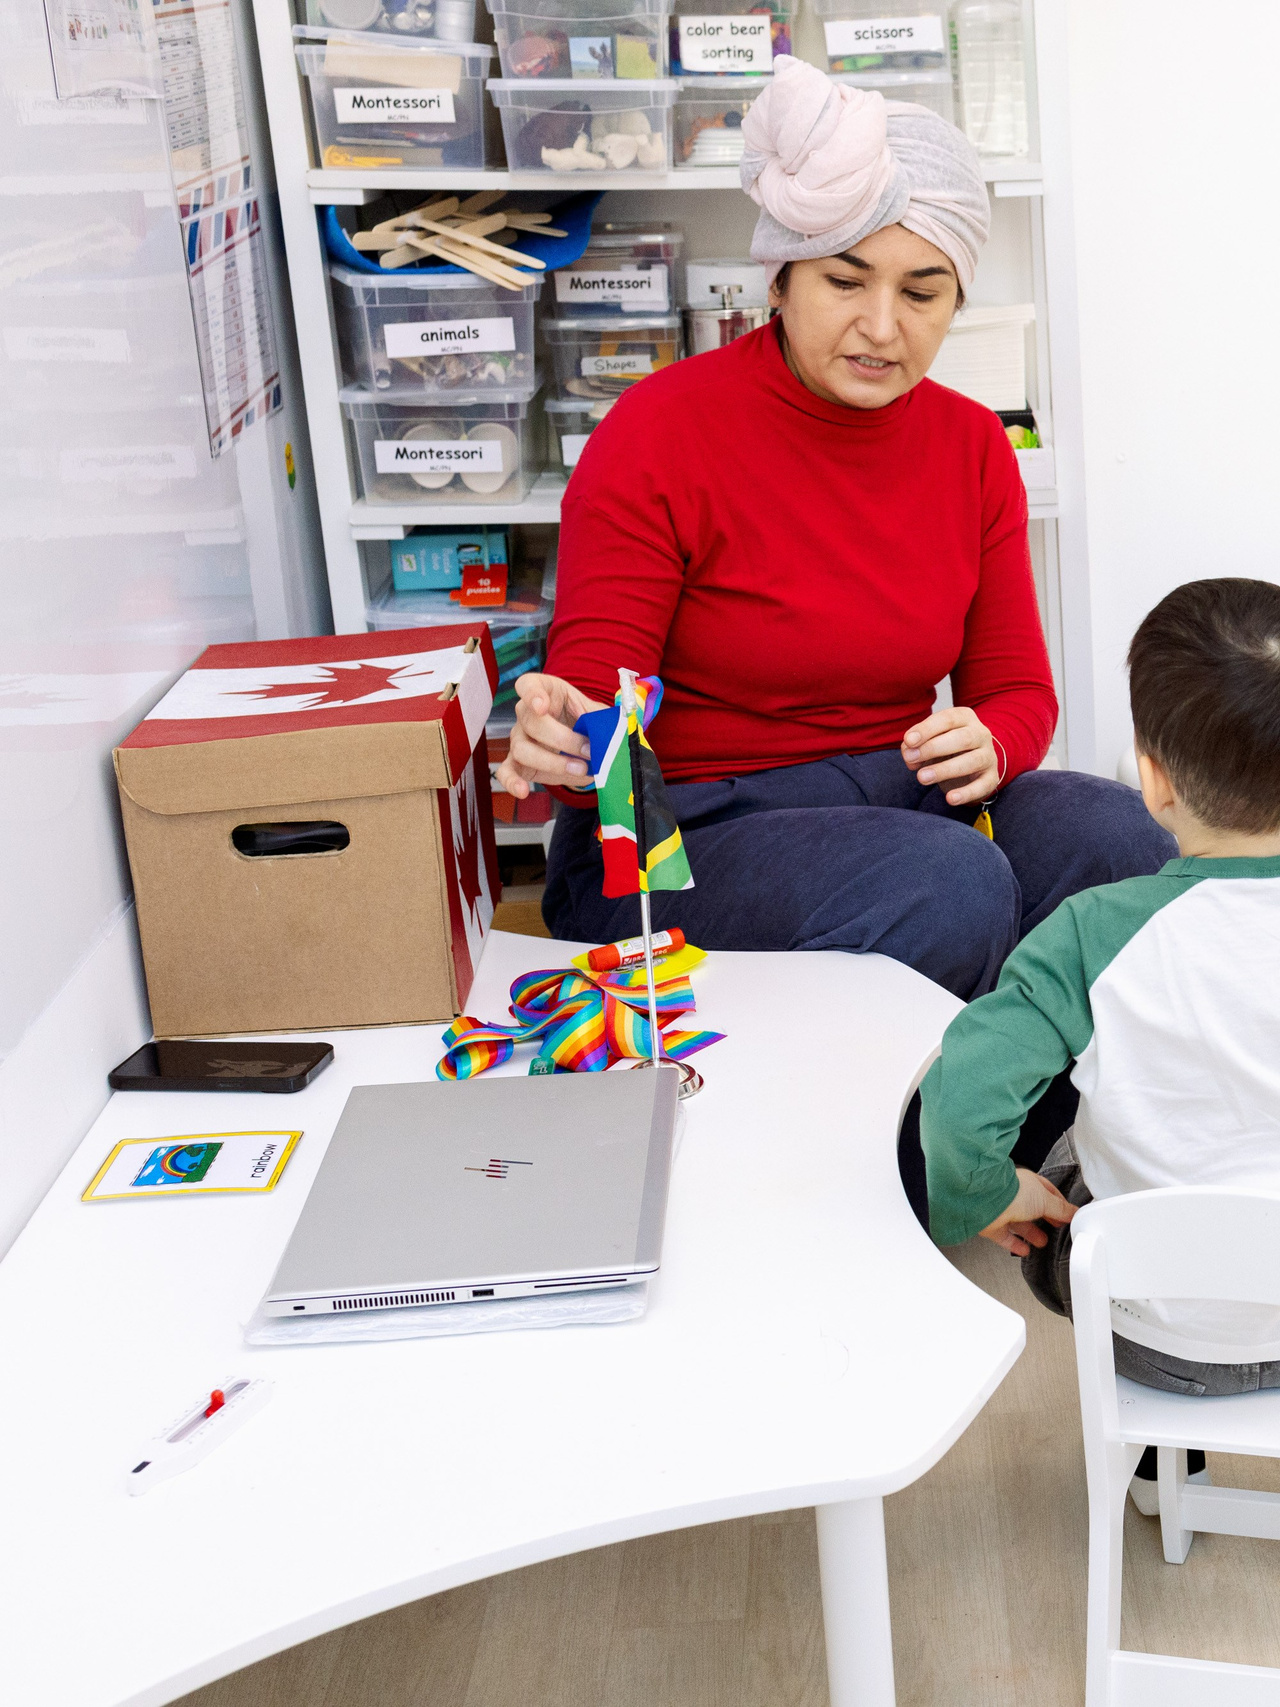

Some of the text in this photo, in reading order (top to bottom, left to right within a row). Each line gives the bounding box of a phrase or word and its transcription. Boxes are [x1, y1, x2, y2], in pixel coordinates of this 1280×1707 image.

[686, 22, 765, 36] color bear
[854, 25, 914, 41] scissors
[702, 45, 754, 62] sorting
[352, 94, 441, 109] Montessori
[570, 276, 651, 290] Montessori
[420, 325, 480, 342] animals
[593, 358, 636, 372] Shapes
[395, 446, 483, 460] Montessori
[477, 578, 491, 587] 10
[250, 1143, 278, 1179] rainbow
